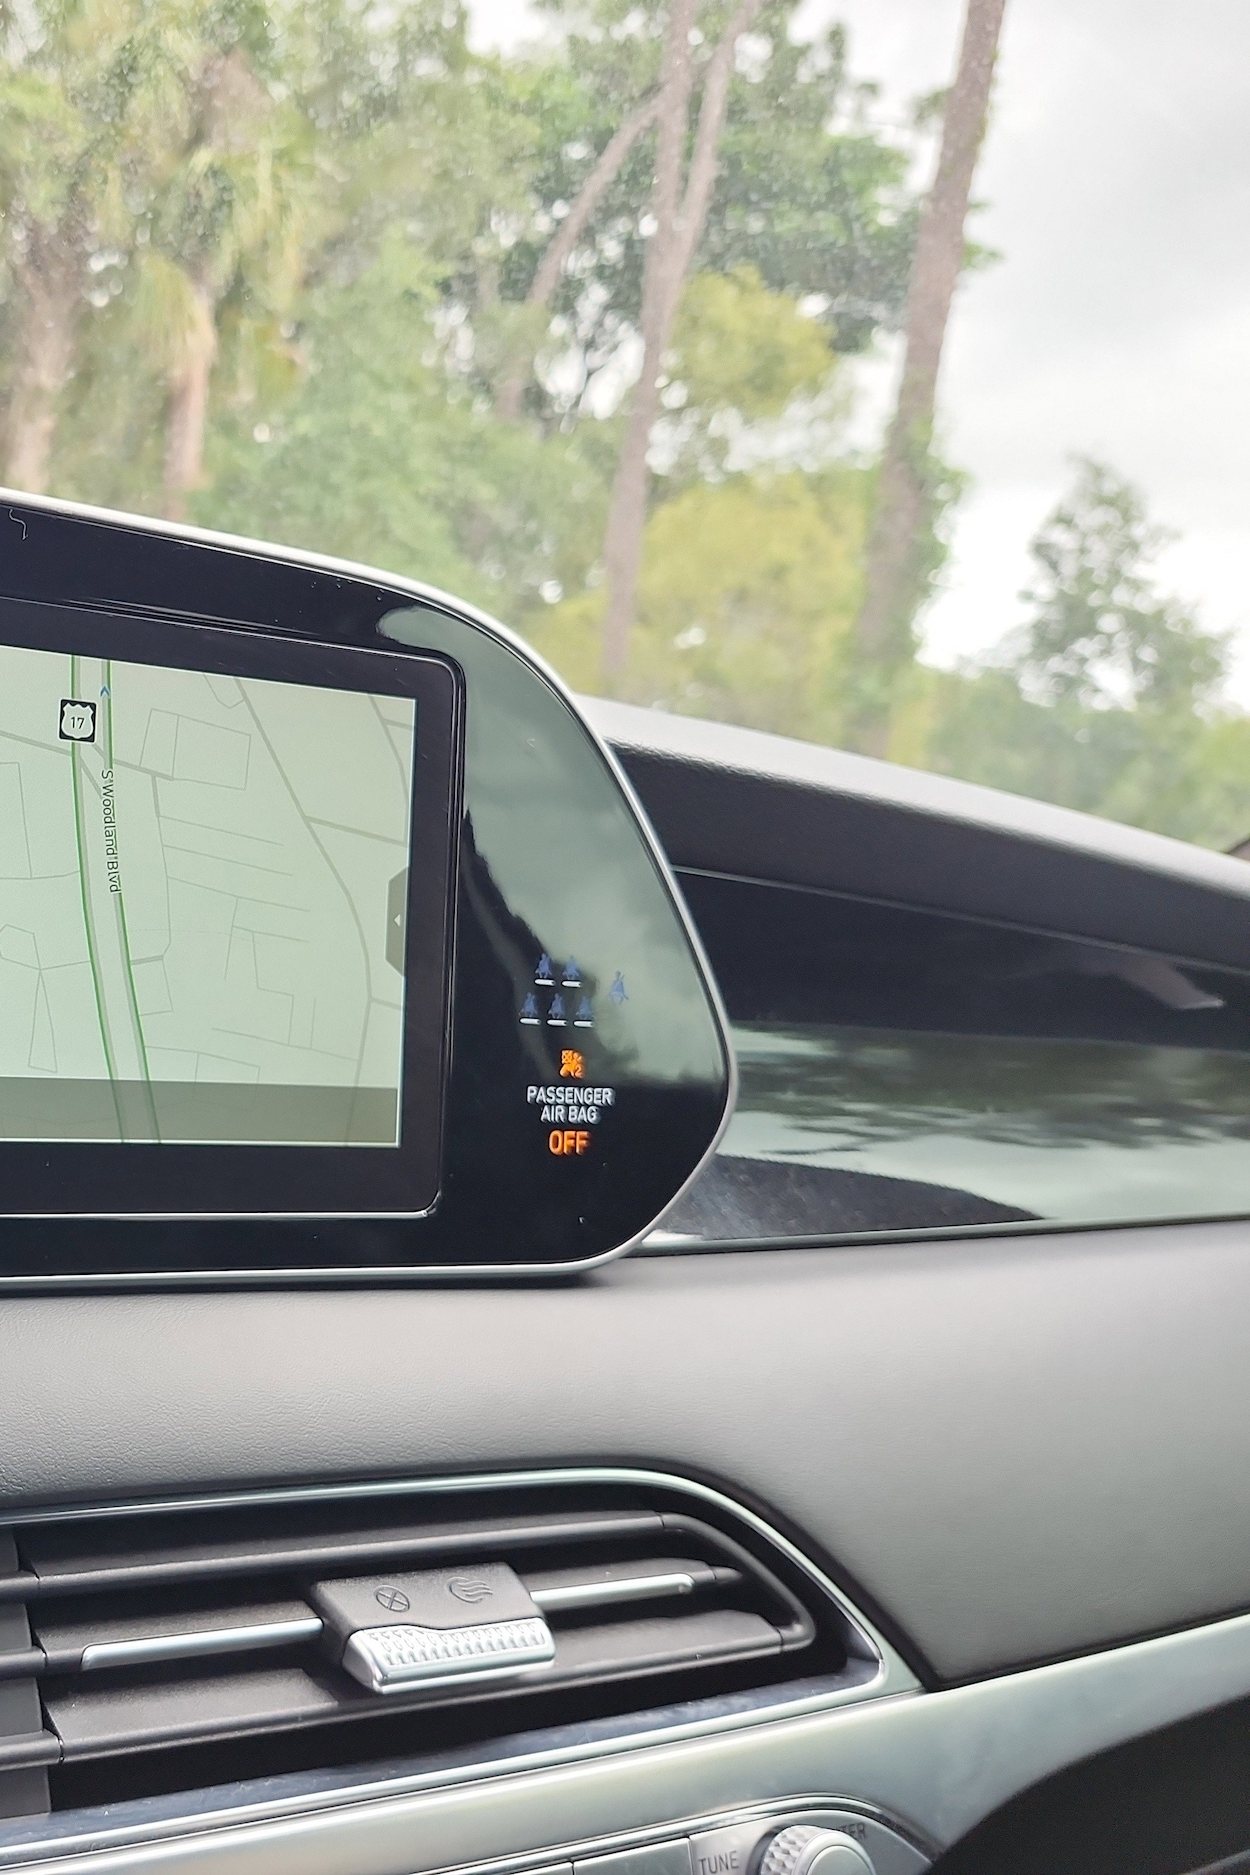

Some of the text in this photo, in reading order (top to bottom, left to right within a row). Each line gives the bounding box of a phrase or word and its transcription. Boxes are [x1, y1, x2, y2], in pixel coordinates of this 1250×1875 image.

[70, 716, 85, 730] 17
[101, 769, 121, 893] S Woodland Blvd
[526, 1085, 616, 1106] PASSENGER
[541, 1105, 601, 1125] AIR BAG
[549, 1130, 591, 1155] OFF
[698, 1851, 739, 1875] TUNE
